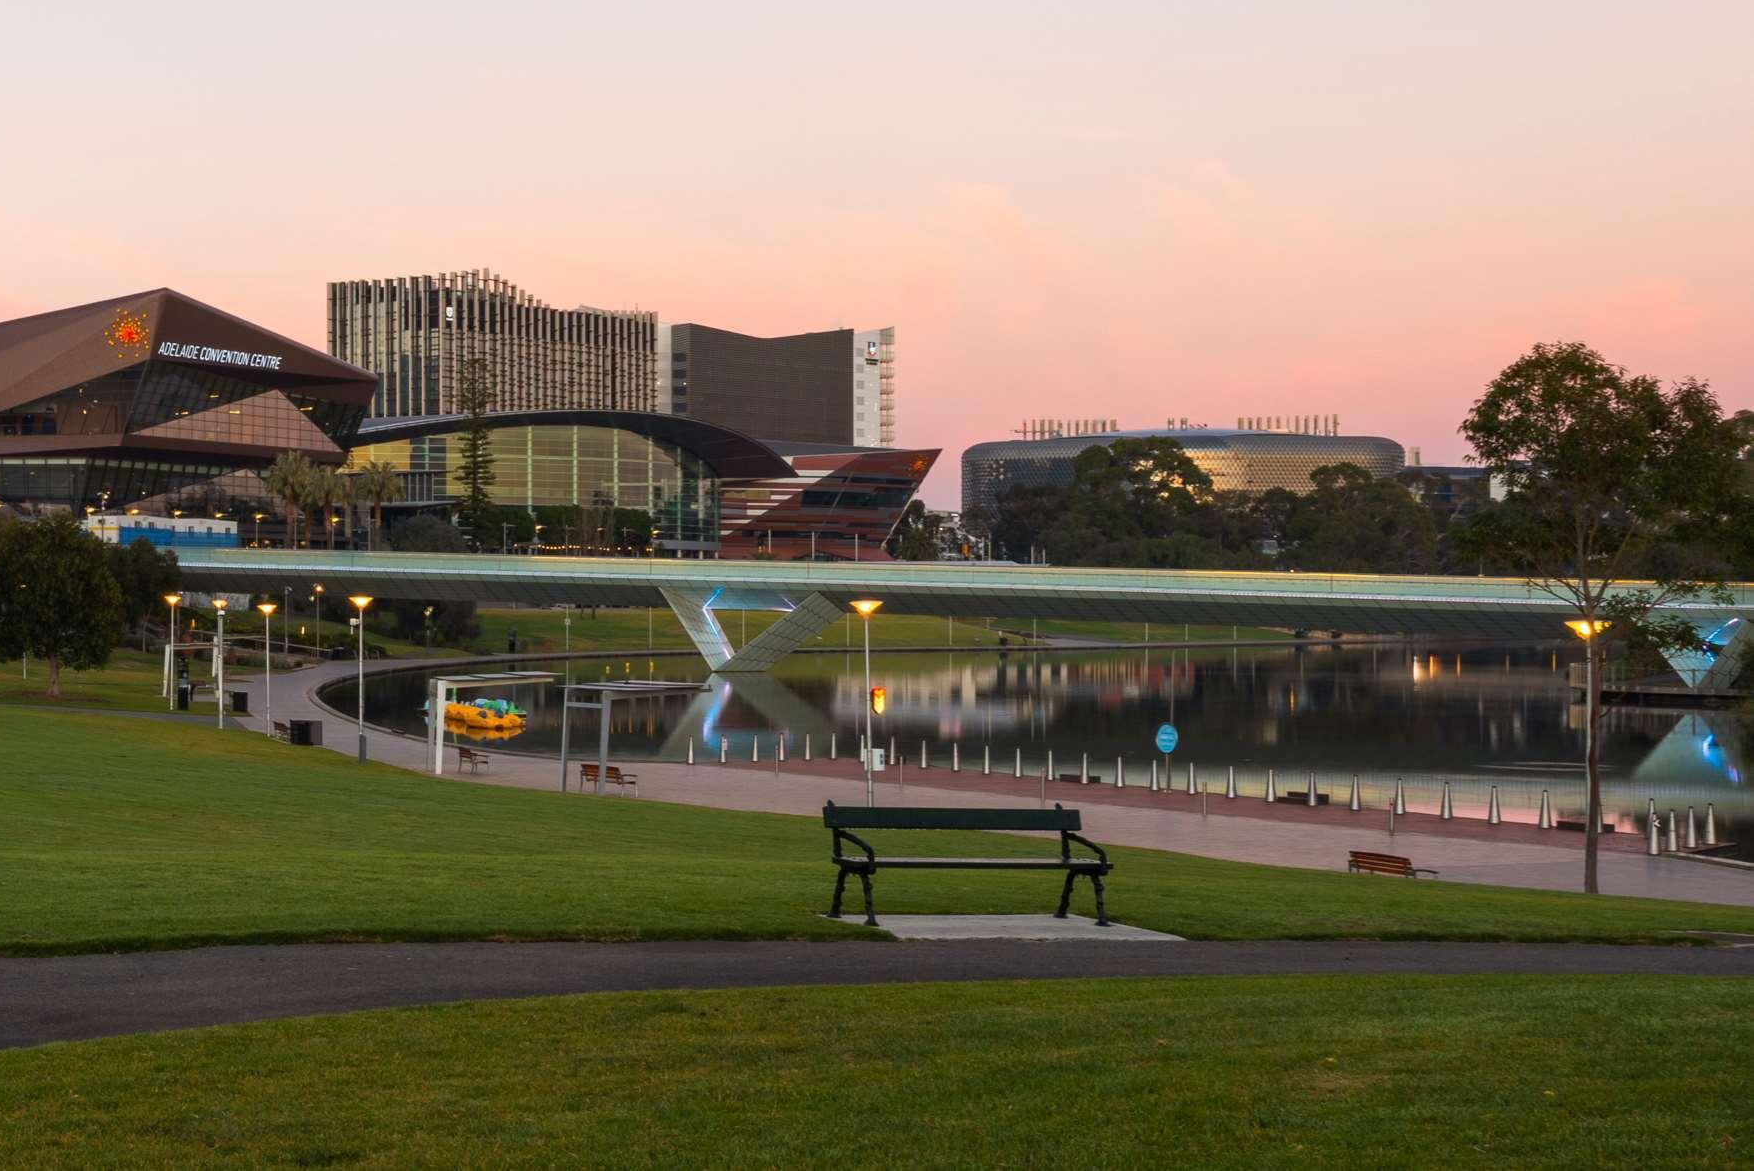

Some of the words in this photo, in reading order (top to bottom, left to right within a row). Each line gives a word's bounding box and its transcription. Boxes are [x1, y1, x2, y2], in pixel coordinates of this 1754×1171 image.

[158, 341, 201, 360] ADELAIDE
[199, 347, 250, 366] CONVENTION
[250, 353, 283, 370] CENTRE
